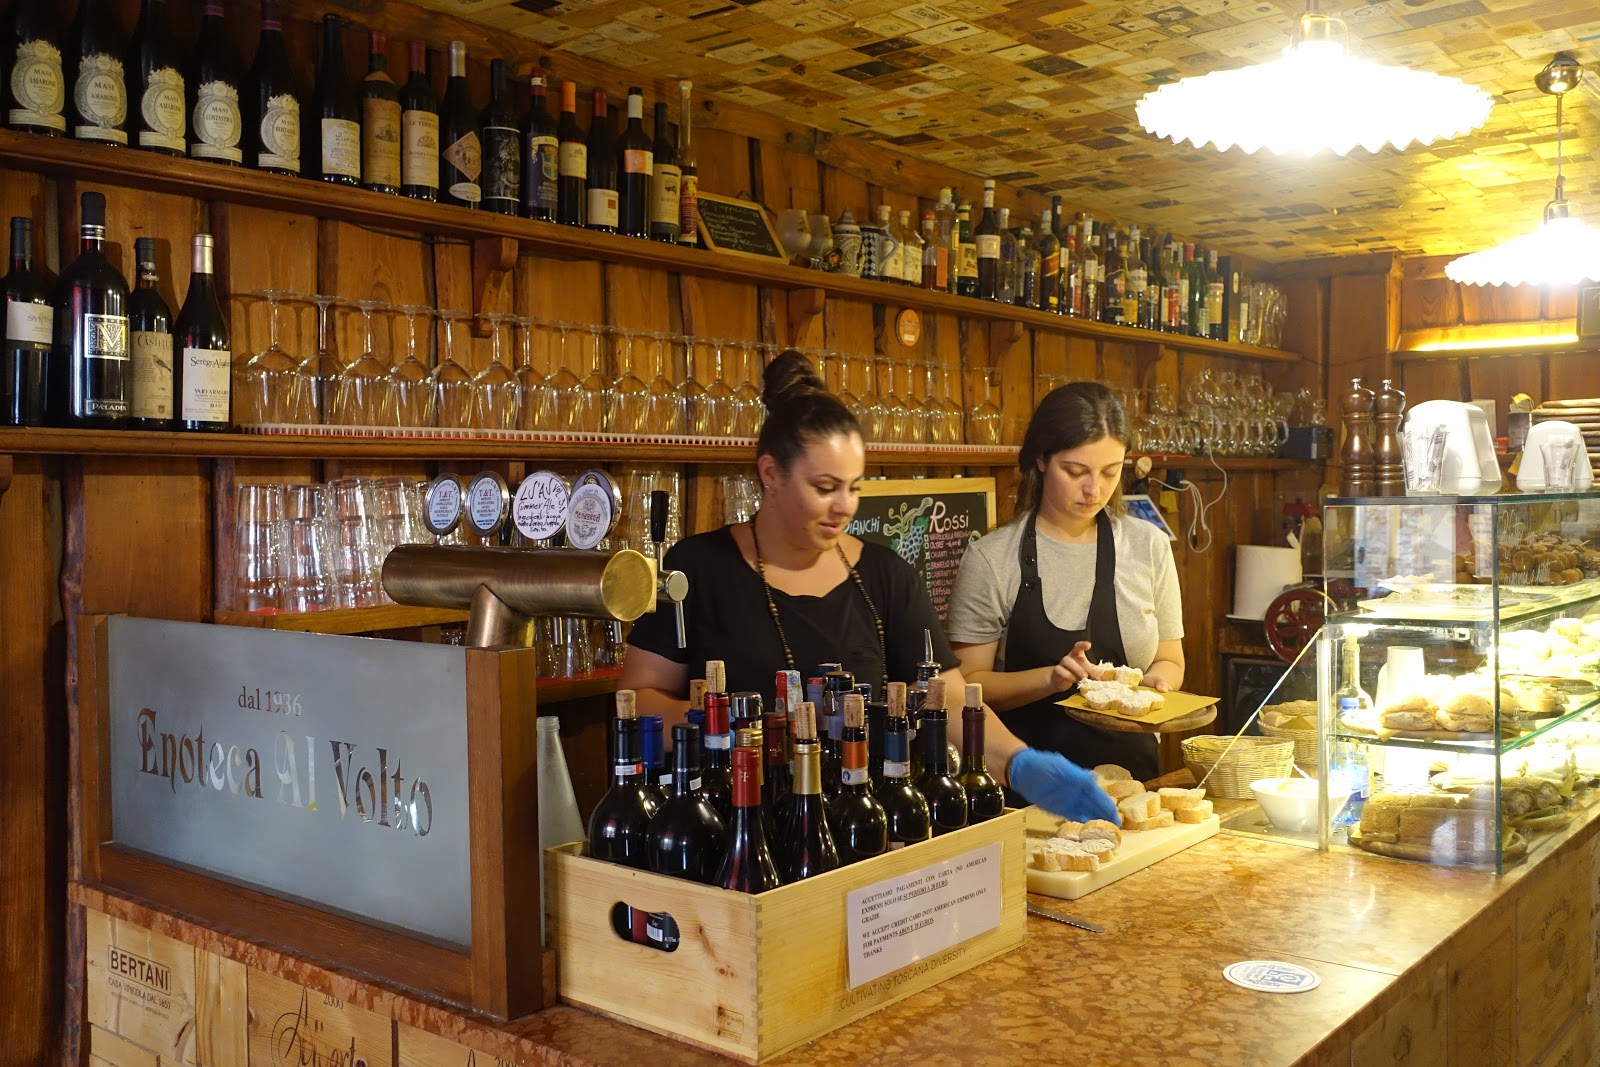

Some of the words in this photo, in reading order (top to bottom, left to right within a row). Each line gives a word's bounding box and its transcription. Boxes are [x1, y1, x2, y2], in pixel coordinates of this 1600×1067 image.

[34, 68, 52, 76] MASI
[94, 82, 114, 91] MASI
[212, 106, 228, 114] MASI
[92, 402, 126, 413] PALADIN
[238, 686, 261, 711] dal
[265, 690, 303, 717] 1936
[137, 707, 264, 799] Enoteca
[274, 730, 319, 812] Al
[329, 740, 433, 837] Volto
[862, 889, 893, 905] ACCETTIAMO
[896, 879, 923, 892] PAGAMENTI
[926, 875, 935, 883] CON
[938, 868, 953, 878] CARTA
[966, 857, 987, 869] AMERICAN
[884, 898, 897, 907] SOLO
[862, 931, 870, 939] WE
[872, 924, 890, 936] ACCEPT
[891, 916, 908, 929] CREDIT
[909, 912, 921, 922] CARD
[934, 900, 956, 912] AMERICAN
[976, 888, 987, 897] ONLY
[862, 912, 880, 924] GRAZIE
[862, 939, 872, 950] FOR
[873, 931, 898, 945] PAYMENTS
[863, 947, 882, 959] THANKS
[111, 950, 168, 990] BERTANI
[840, 981, 891, 1010] CULTIVATING
[893, 963, 929, 986] TOSCANA
[930, 946, 967, 970] DIVERSITY
[108, 977, 122, 990] CASA
[123, 982, 146, 1000] VINICOLA
[147, 993, 158, 1004] DAL
